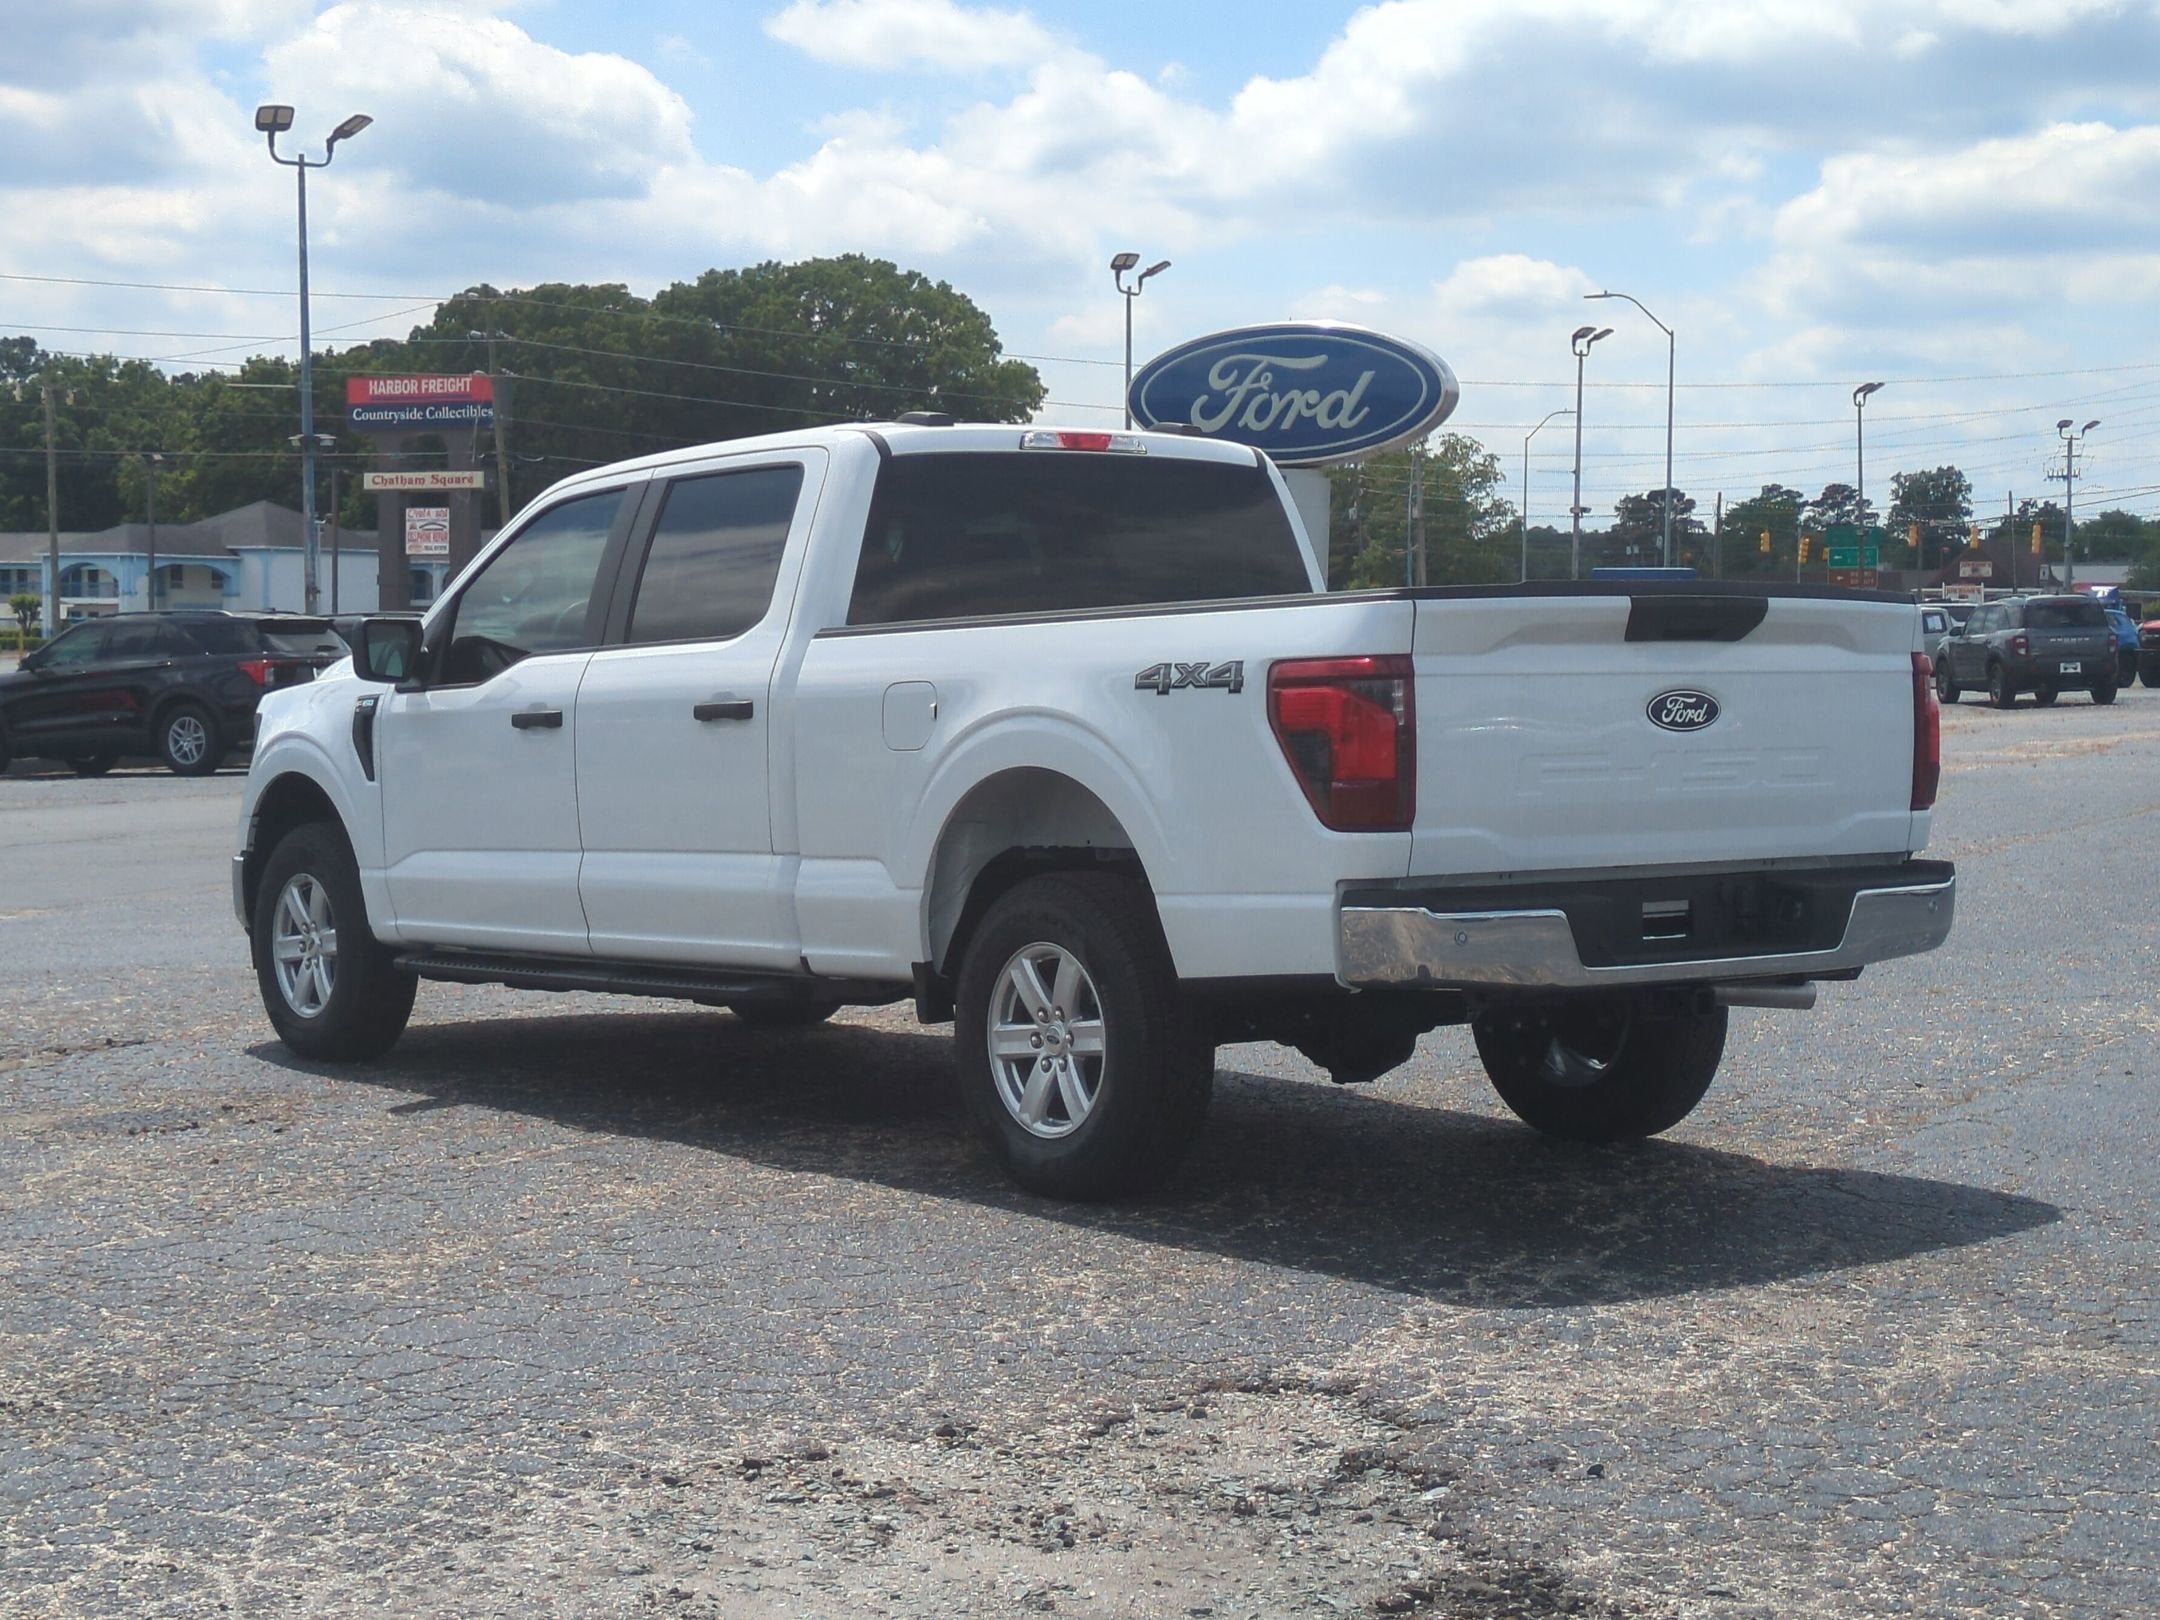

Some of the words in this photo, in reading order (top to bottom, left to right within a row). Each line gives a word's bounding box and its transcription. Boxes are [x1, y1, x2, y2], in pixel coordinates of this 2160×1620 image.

[368, 379, 419, 395] HARBOR
[421, 377, 472, 394] FREIGHT
[1190, 353, 1376, 433] Ford
[352, 407, 423, 424] Countryside
[426, 404, 494, 420] Collectibles
[372, 475, 426, 487] Chatham
[431, 474, 474, 486] Square
[1661, 696, 1708, 723] Ford
